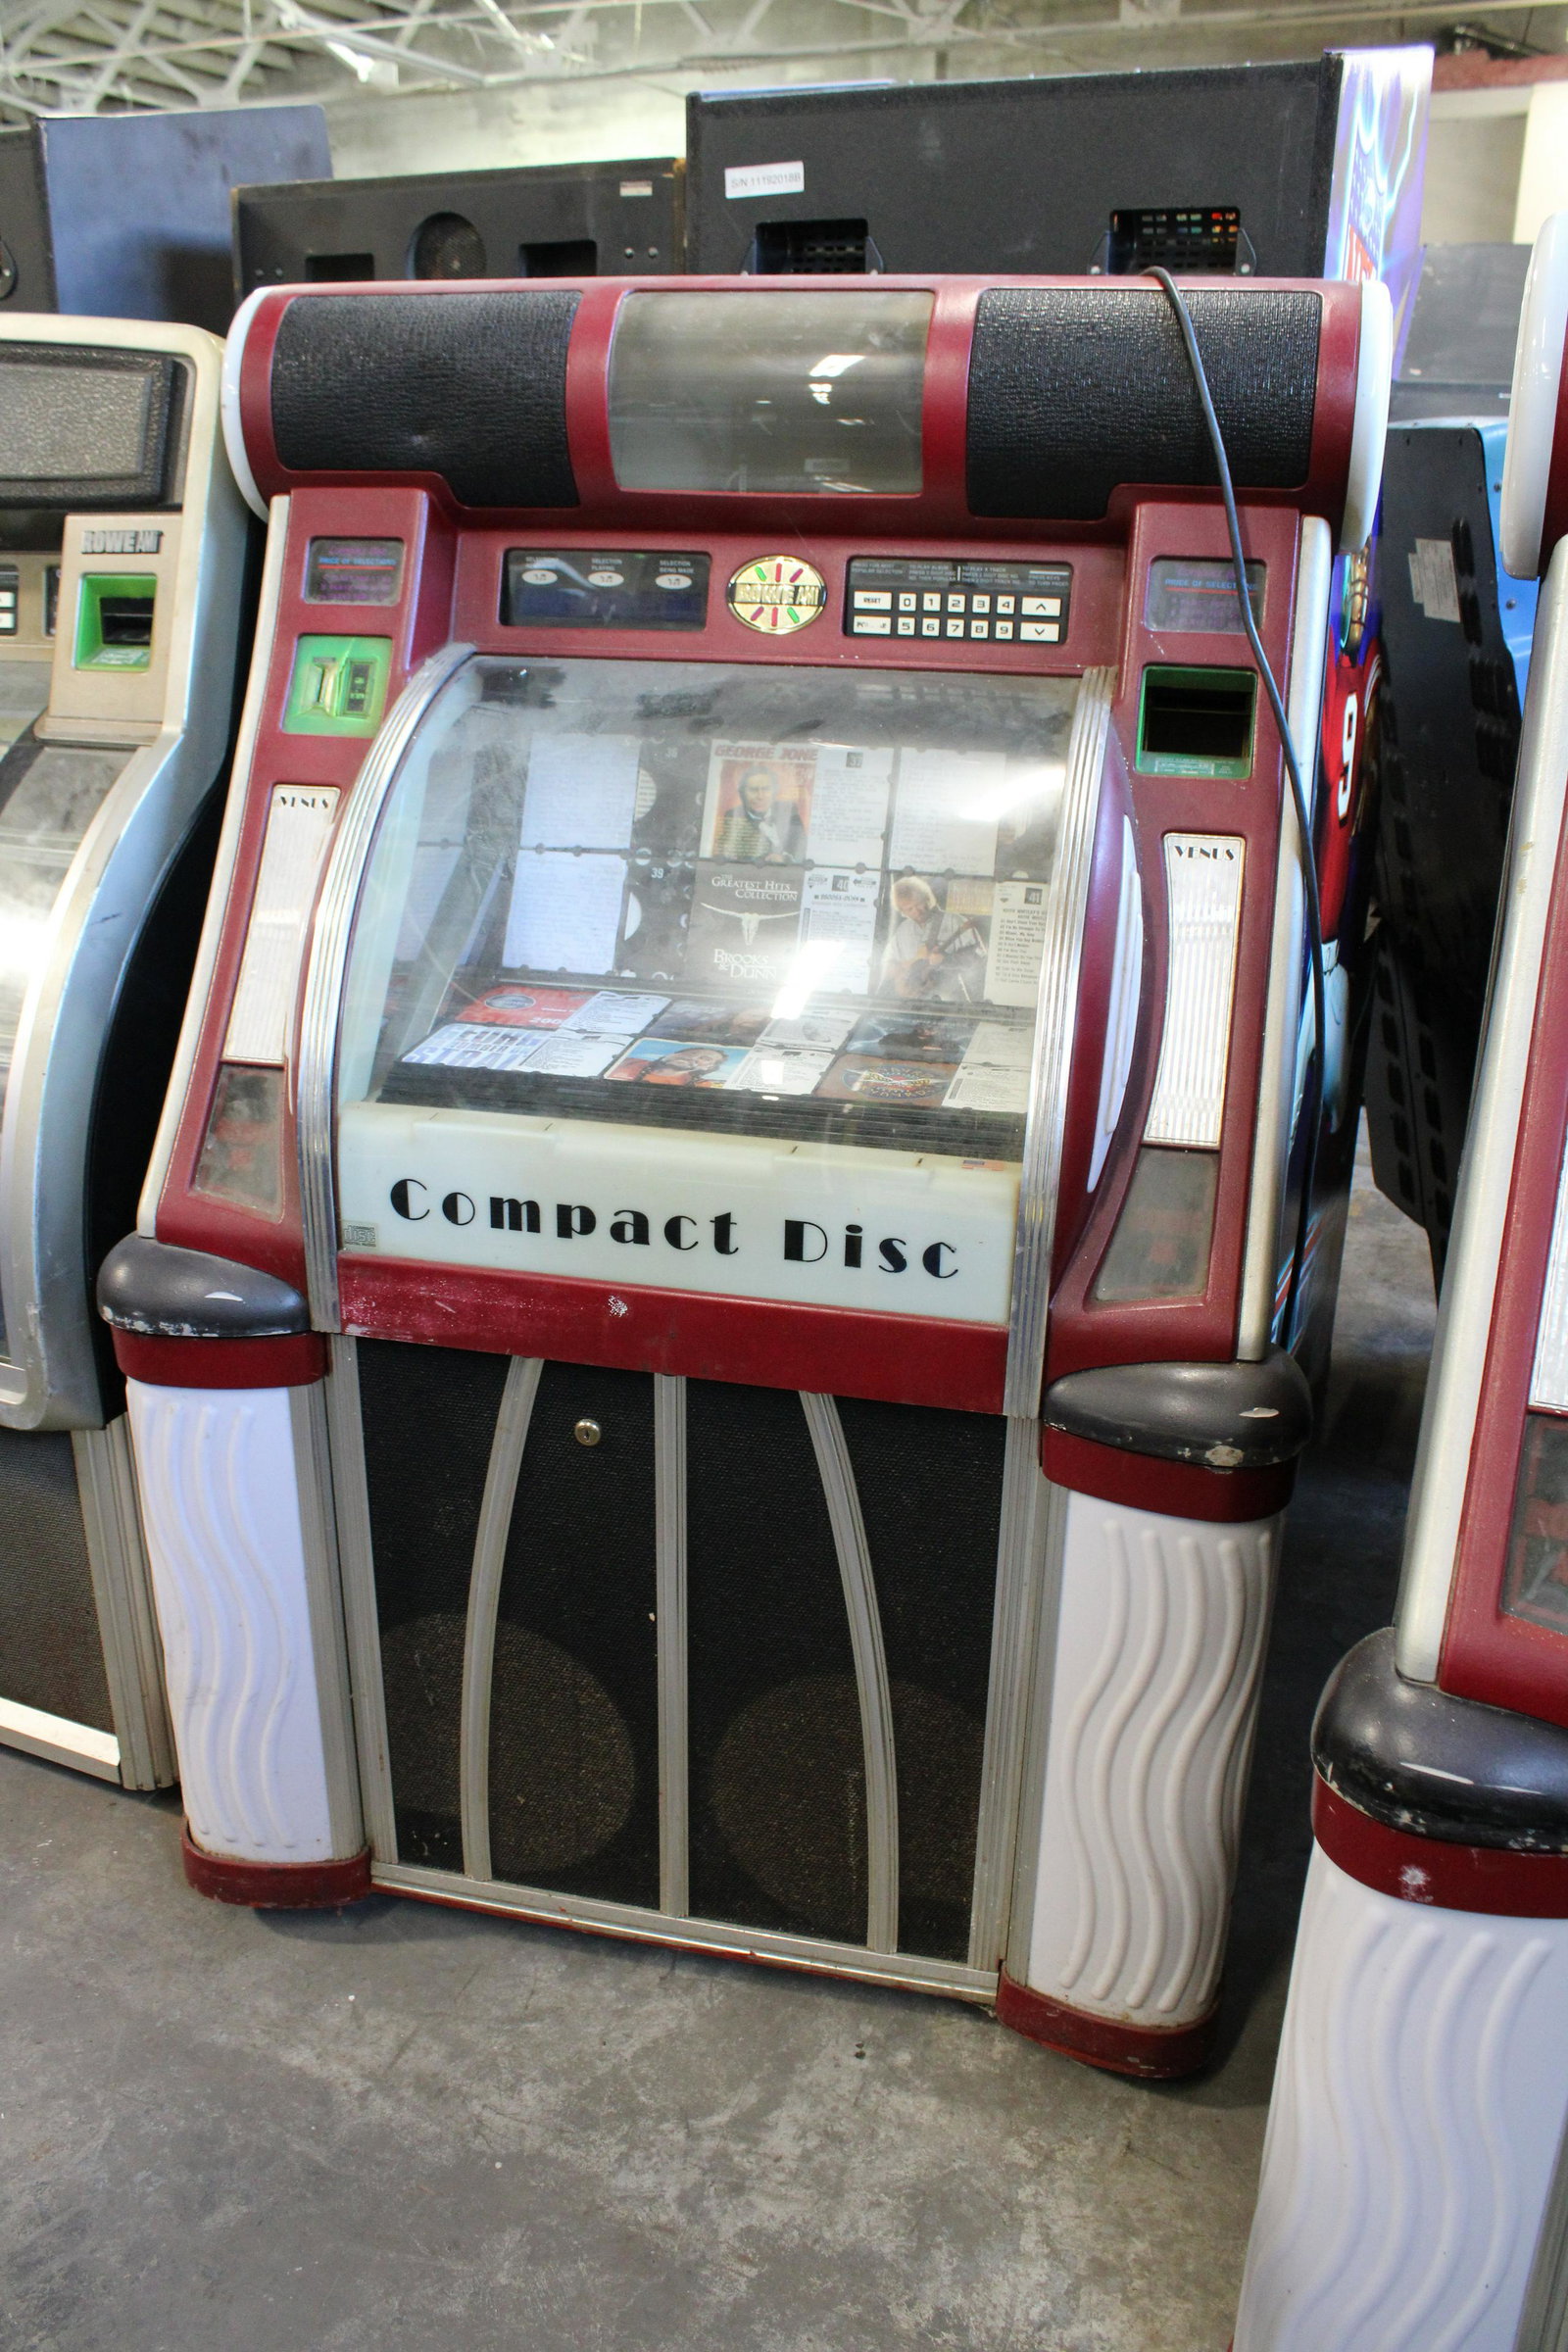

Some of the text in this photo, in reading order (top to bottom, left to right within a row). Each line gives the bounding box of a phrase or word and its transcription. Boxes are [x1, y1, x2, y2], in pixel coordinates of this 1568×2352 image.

[81, 530, 137, 554] ROWE
[904, 598, 911, 607] 0
[952, 599, 960, 609] 2
[976, 600, 986, 609] 3
[1002, 601, 1010, 610] 4
[902, 622, 910, 631] 5
[926, 623, 935, 632] 6
[951, 624, 959, 633] 7
[975, 625, 984, 634] 8
[1000, 626, 1008, 635] 9
[714, 745, 776, 759] GEORGE
[651, 867, 664, 879] 39
[711, 876, 762, 890] GREATEST
[764, 879, 792, 892] HITS
[735, 888, 798, 902] COLLECTION
[713, 948, 769, 966] BROOKS
[729, 964, 777, 980] DUNN
[389, 1178, 958, 1279] Compact Disc
